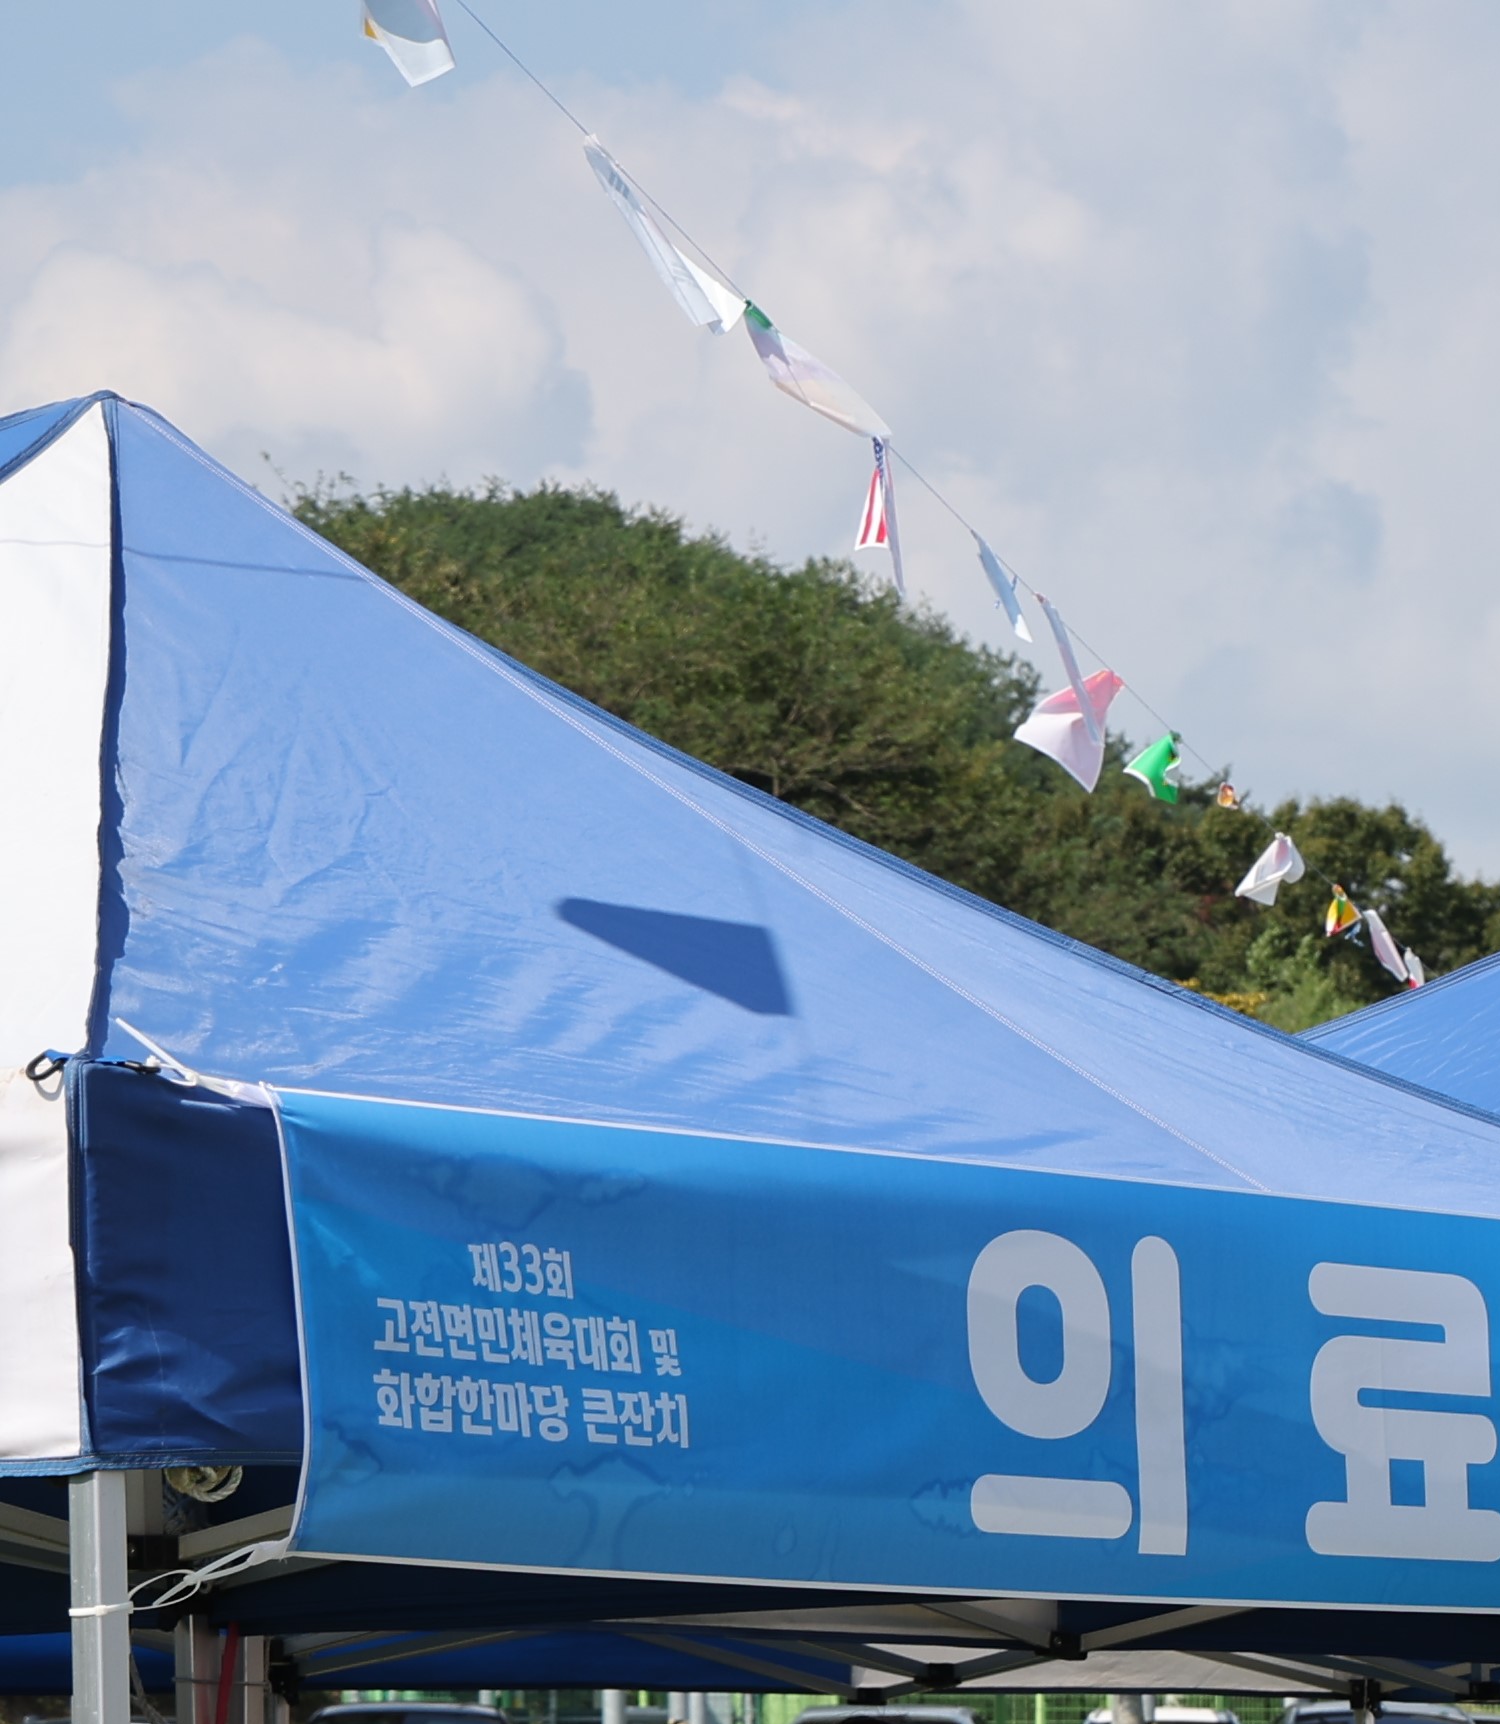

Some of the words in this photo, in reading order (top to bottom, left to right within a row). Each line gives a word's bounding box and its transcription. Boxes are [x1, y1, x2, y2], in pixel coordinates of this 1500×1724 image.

[467, 1241, 575, 1300] 제33회
[373, 1296, 642, 1375] 고전면민체육대회
[648, 1328, 682, 1377] 및
[372, 1368, 569, 1443] 화합한마당
[581, 1387, 689, 1449] 큰잔치
